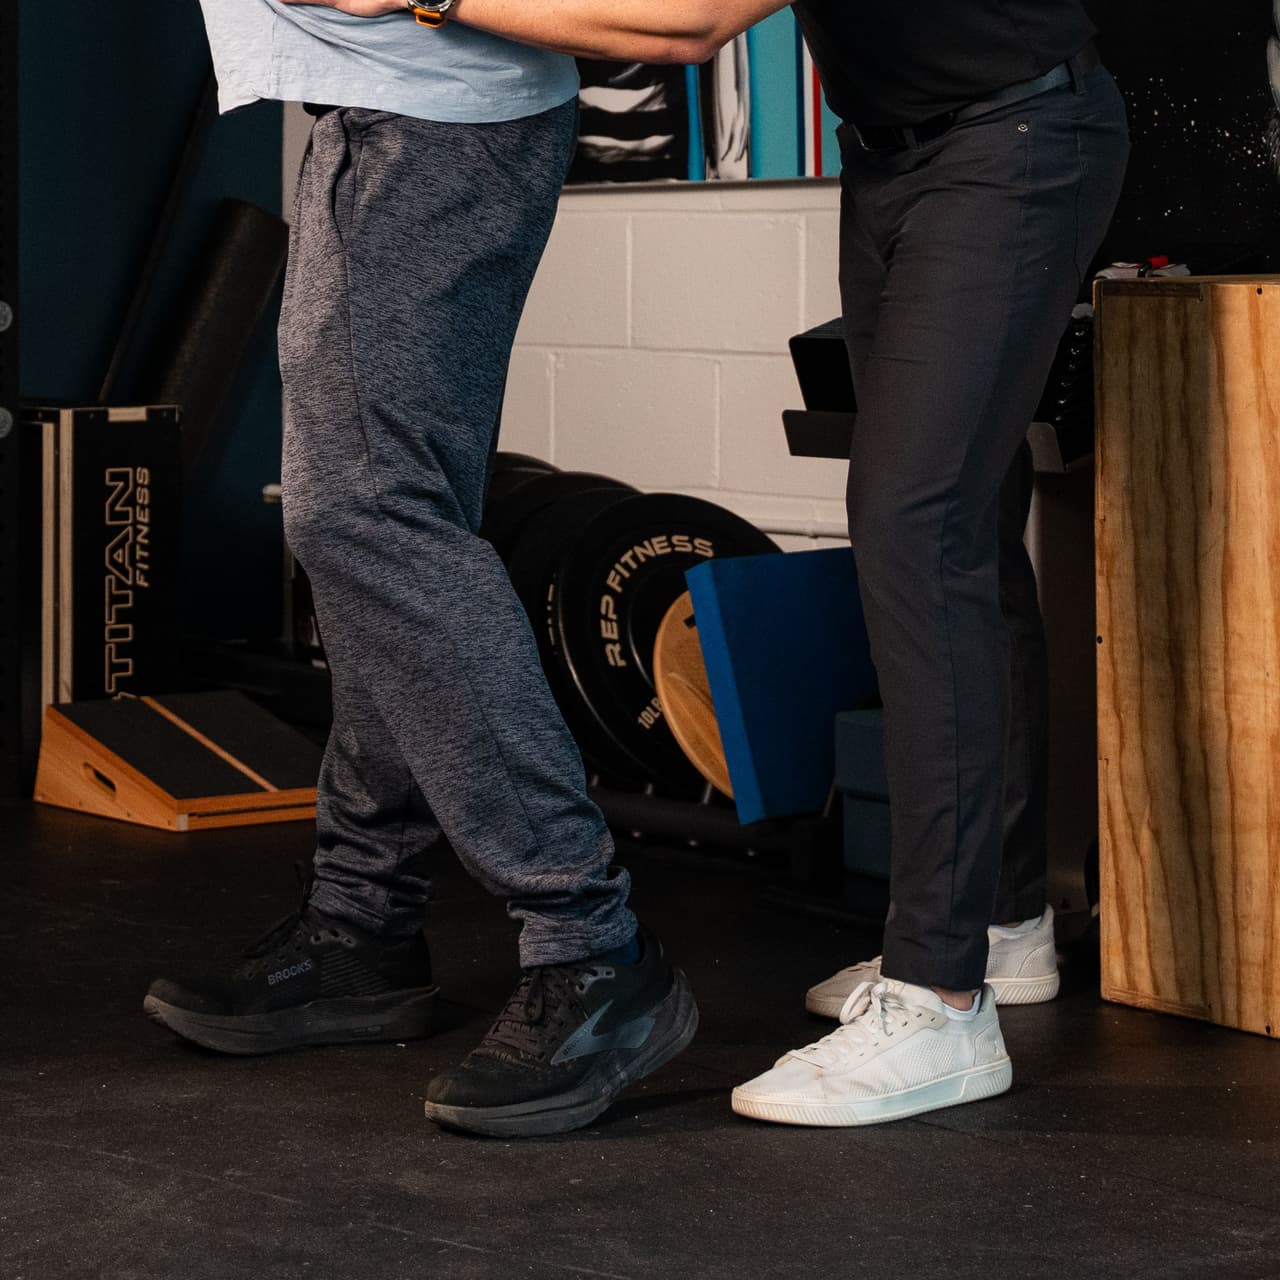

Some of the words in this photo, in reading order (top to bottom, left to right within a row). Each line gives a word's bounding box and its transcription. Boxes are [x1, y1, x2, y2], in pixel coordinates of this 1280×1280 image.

[136, 466, 151, 588] FITNESS
[606, 534, 715, 593] FITNESS
[105, 467, 134, 693] TITAN
[600, 594, 627, 667] REP
[267, 958, 312, 986] BROOKS
